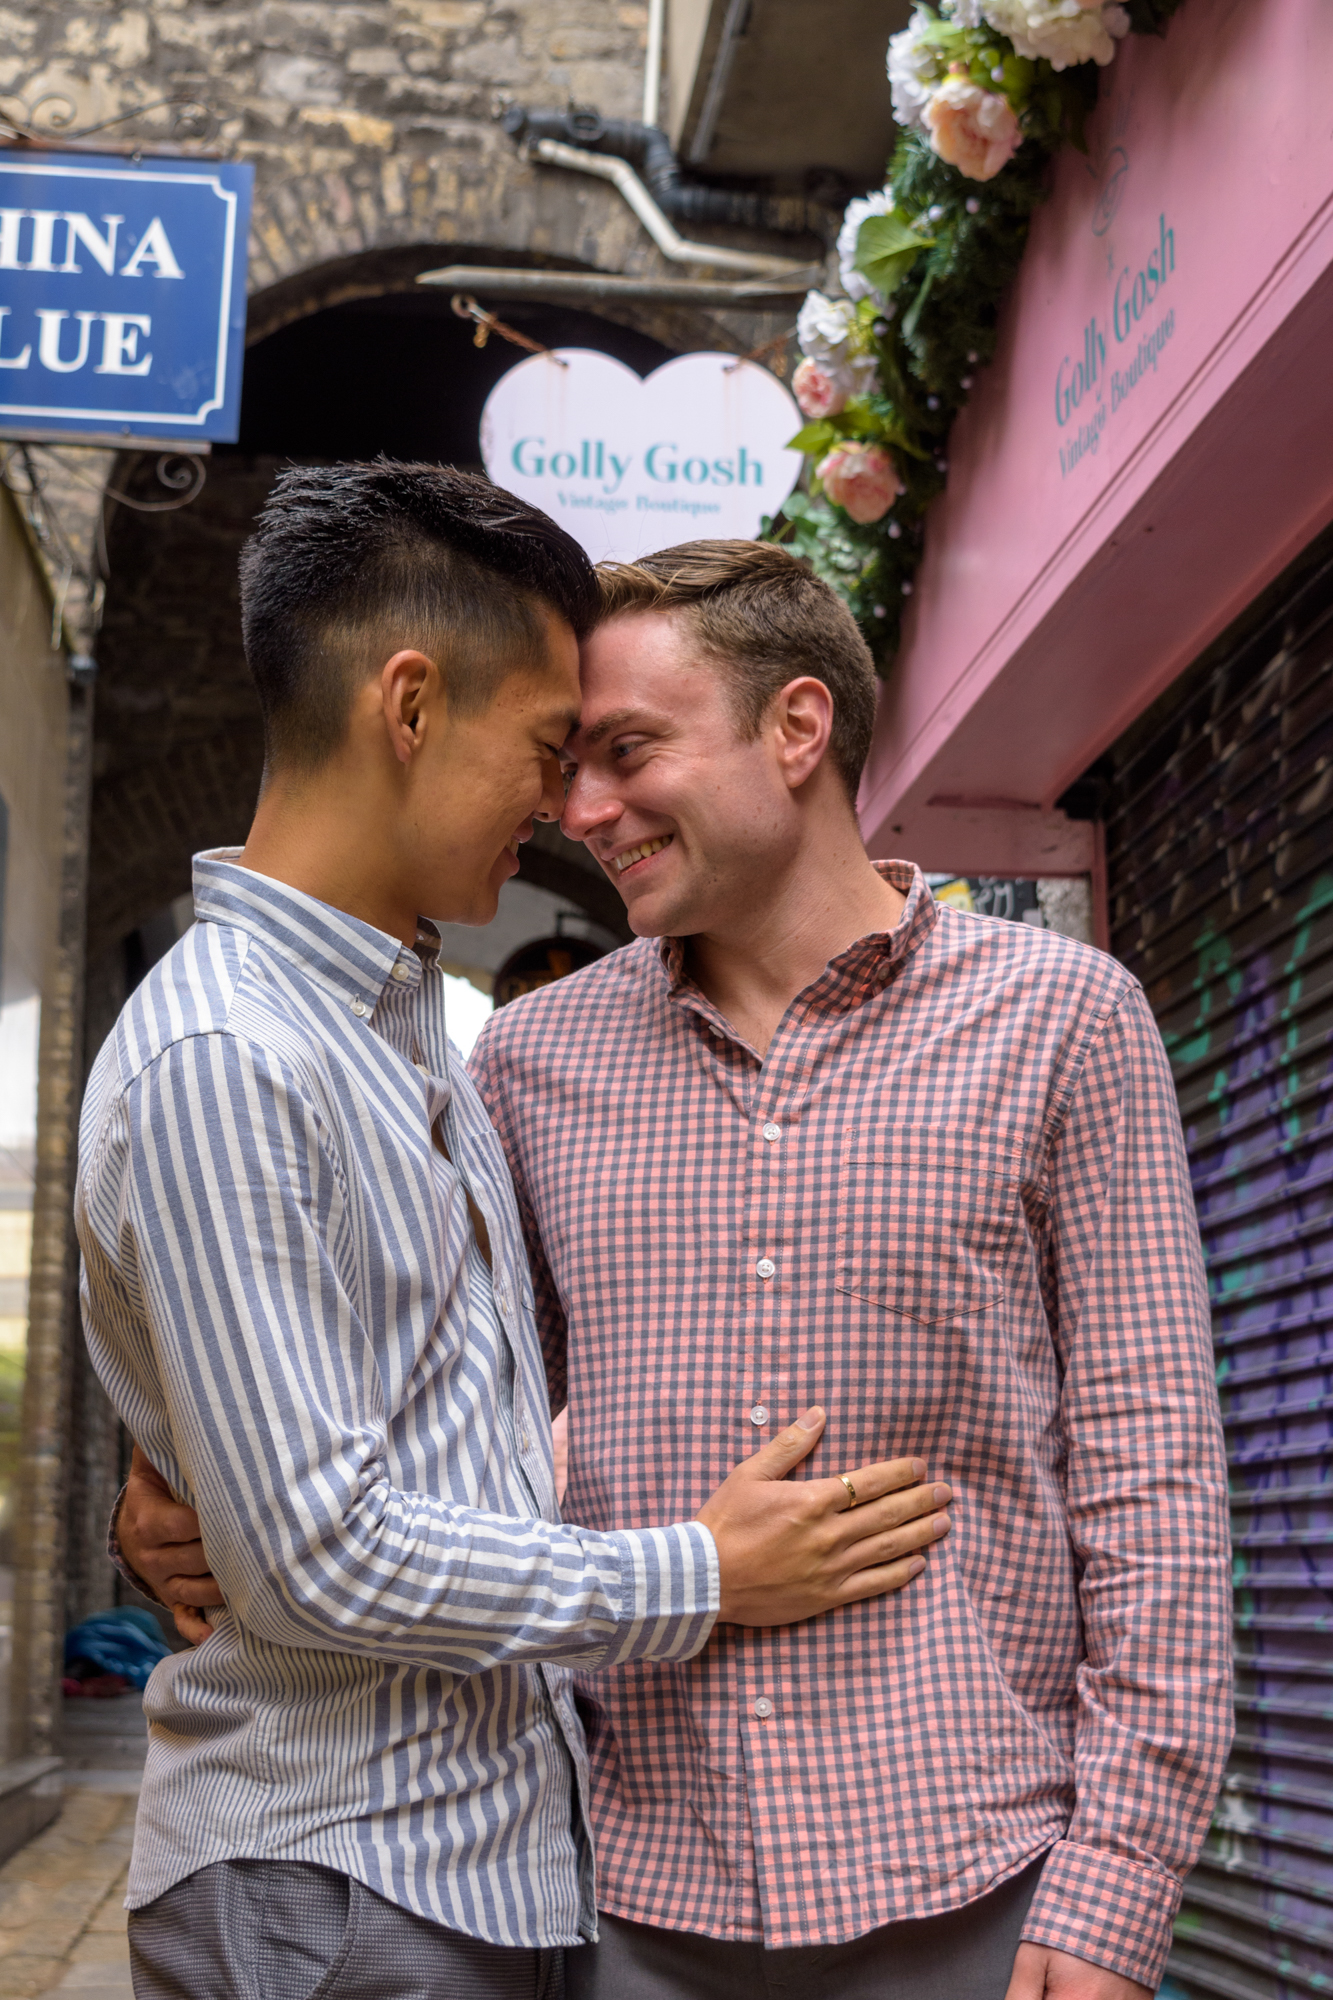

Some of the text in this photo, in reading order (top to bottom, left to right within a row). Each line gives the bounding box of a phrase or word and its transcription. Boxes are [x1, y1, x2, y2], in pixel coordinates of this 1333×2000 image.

[1054, 212, 1175, 427] Golly Gosh
[1059, 307, 1175, 480] Vintage Boutique
[511, 436, 764, 494] Golly Gosh
[557, 491, 628, 514] Vintage
